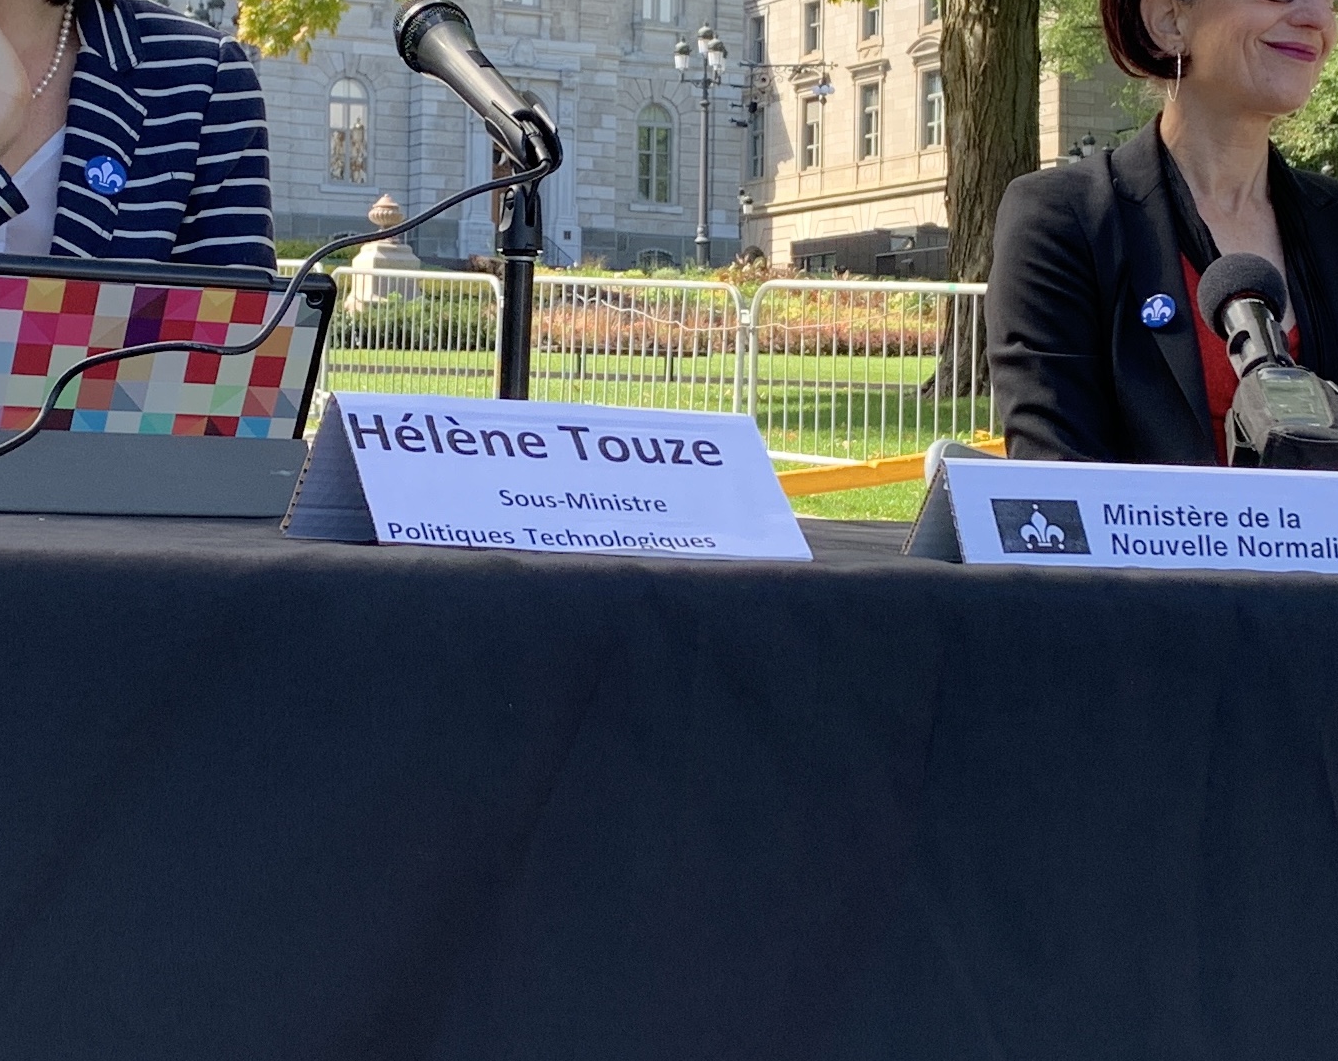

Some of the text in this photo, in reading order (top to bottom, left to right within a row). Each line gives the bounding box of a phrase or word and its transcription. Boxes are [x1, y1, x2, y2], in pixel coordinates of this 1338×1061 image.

[347, 412, 724, 467] Hélène Touze
[499, 489, 668, 513] Sous-Ministre
[1103, 503, 1302, 529] Ministère de la
[388, 522, 717, 550] Politiques Technologiques
[1111, 532, 1228, 557] Nouvelle
